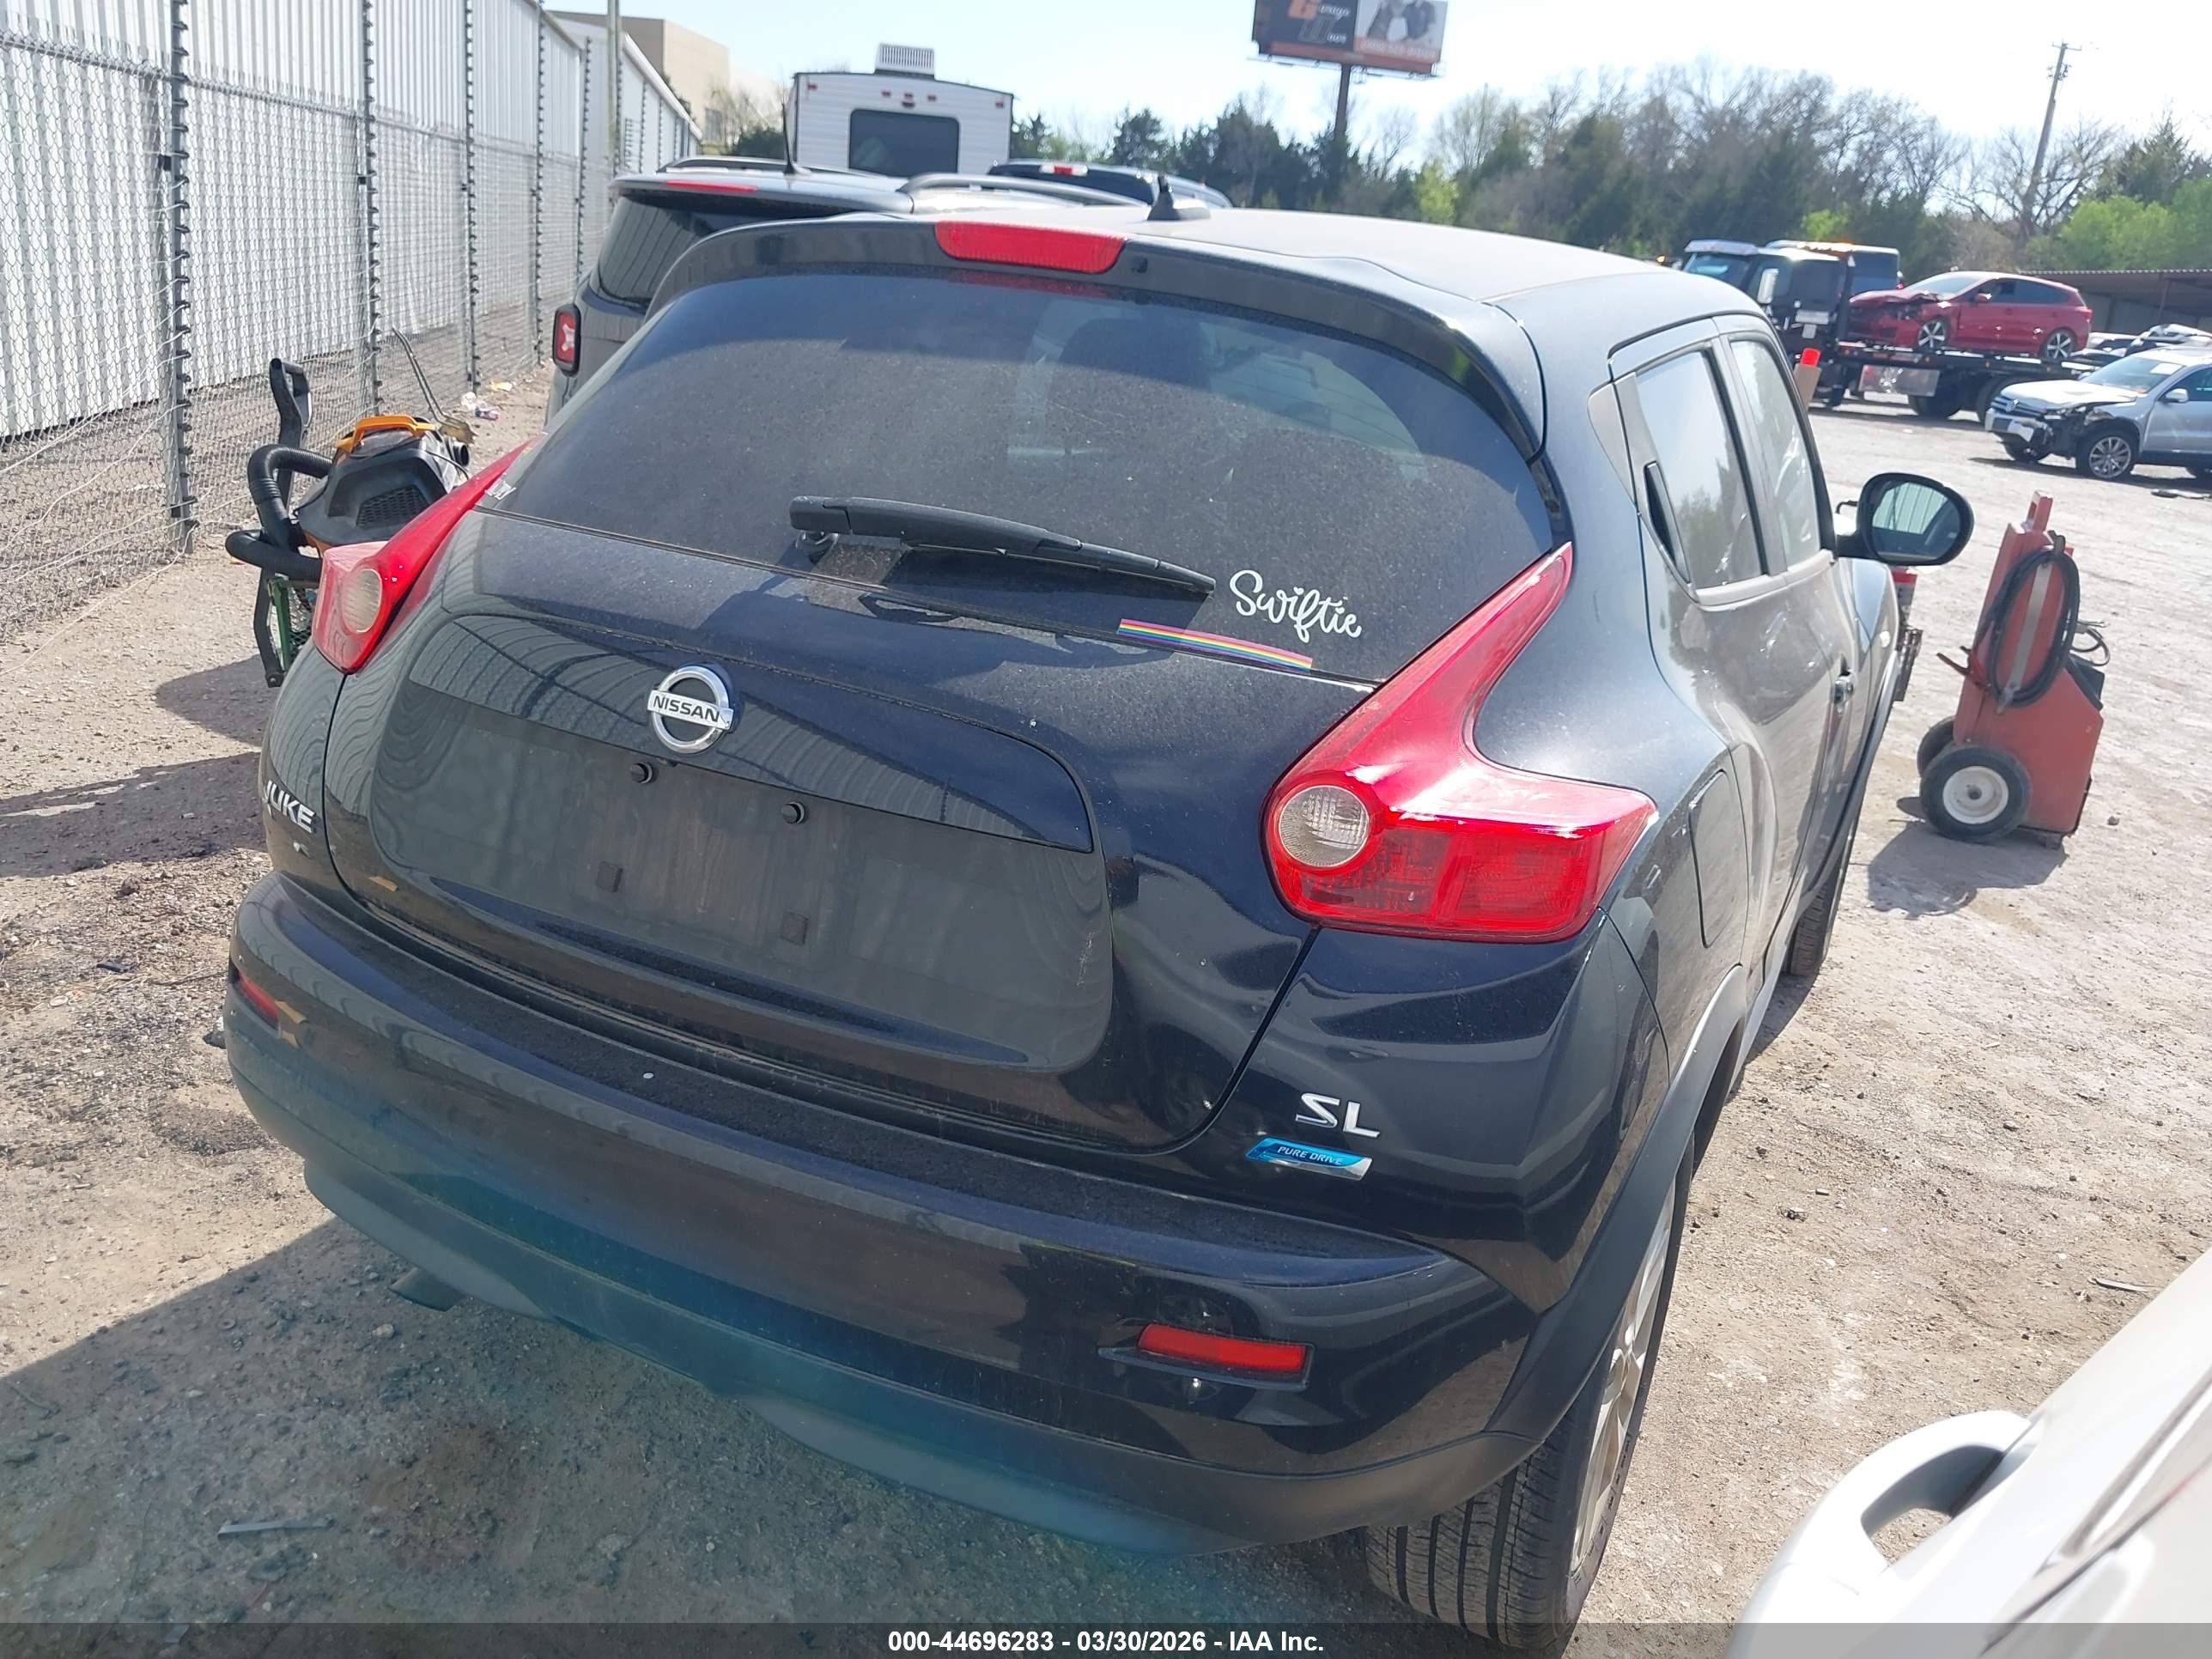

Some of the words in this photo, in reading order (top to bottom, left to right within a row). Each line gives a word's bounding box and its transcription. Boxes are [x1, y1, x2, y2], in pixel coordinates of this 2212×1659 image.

[1229, 569, 1363, 643] Swiftie
[653, 695, 720, 723] NISSAN
[262, 779, 316, 834] JUKE
[1295, 1092, 1381, 1139] SL
[1278, 1146, 1307, 1158] PURE
[1310, 1152, 1343, 1165] DRIVE
